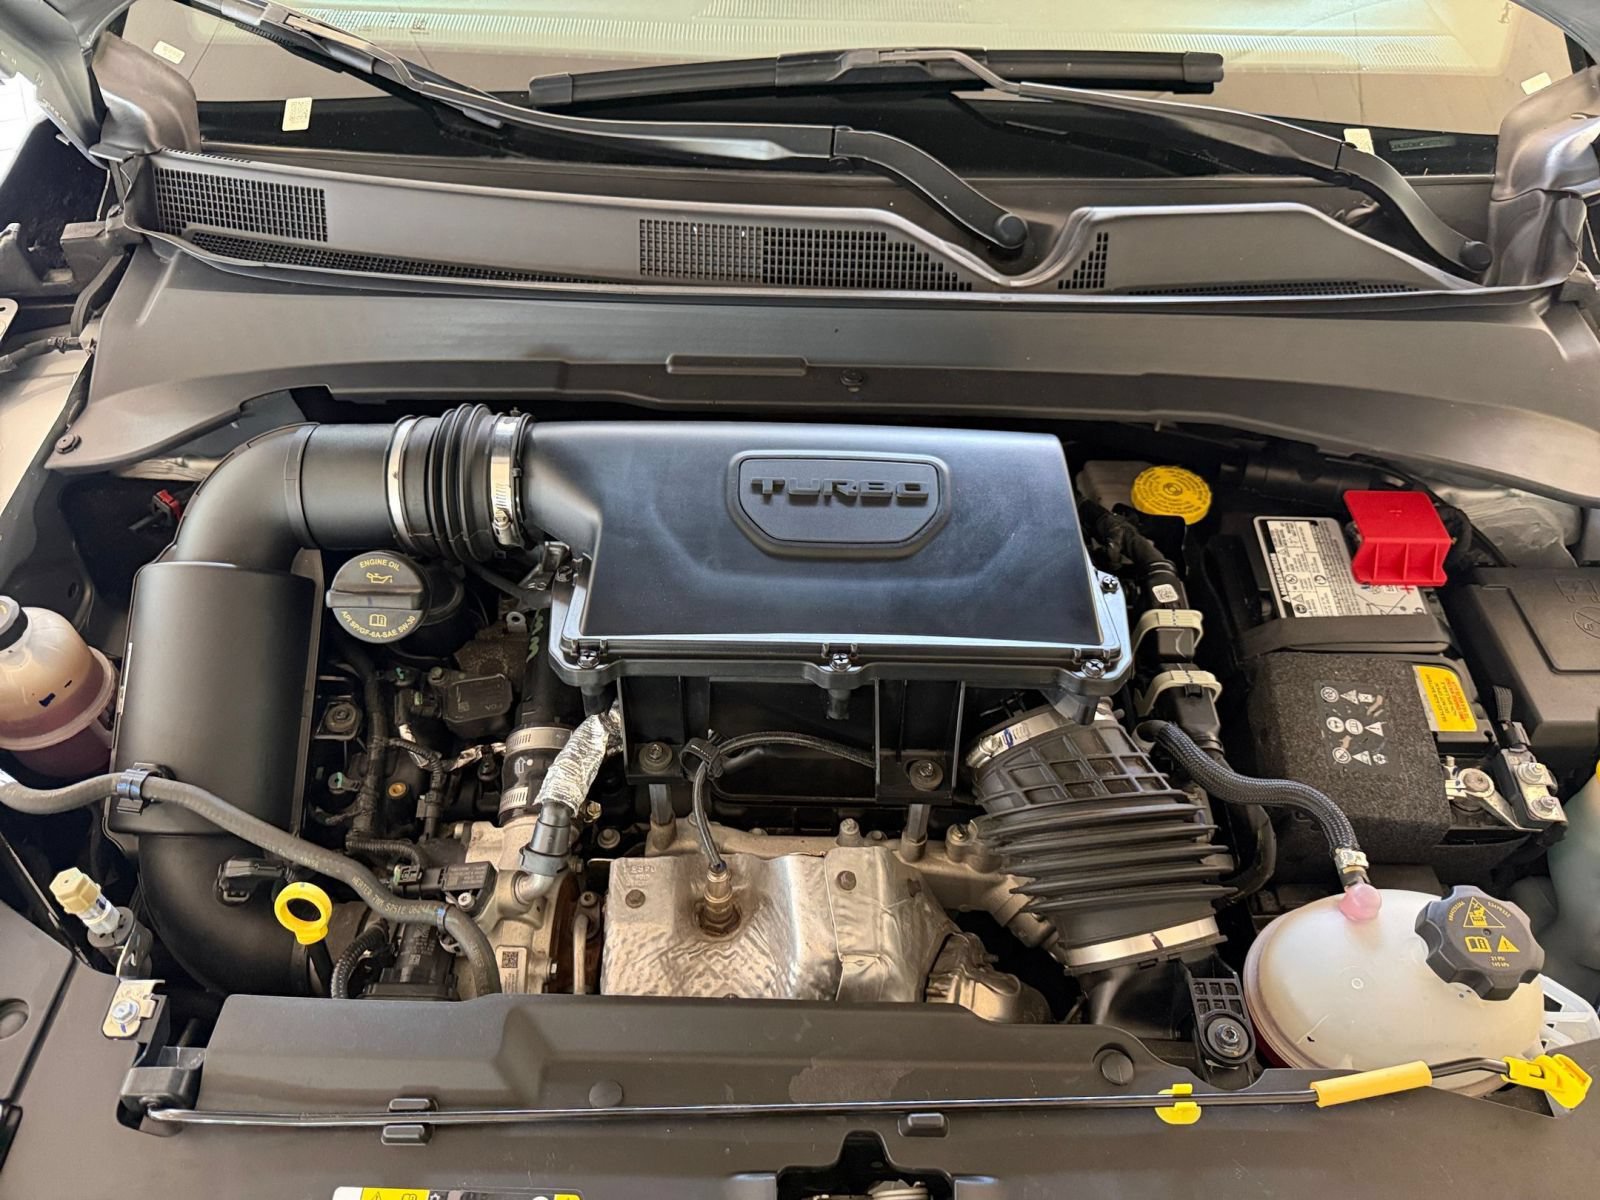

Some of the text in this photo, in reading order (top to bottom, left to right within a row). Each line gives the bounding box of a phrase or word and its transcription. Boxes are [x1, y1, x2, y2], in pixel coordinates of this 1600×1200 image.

[751, 477, 929, 498] TURBO
[360, 558, 400, 571] ENGINE OIL
[342, 612, 352, 622] API
[398, 615, 416, 633] 5W-30
